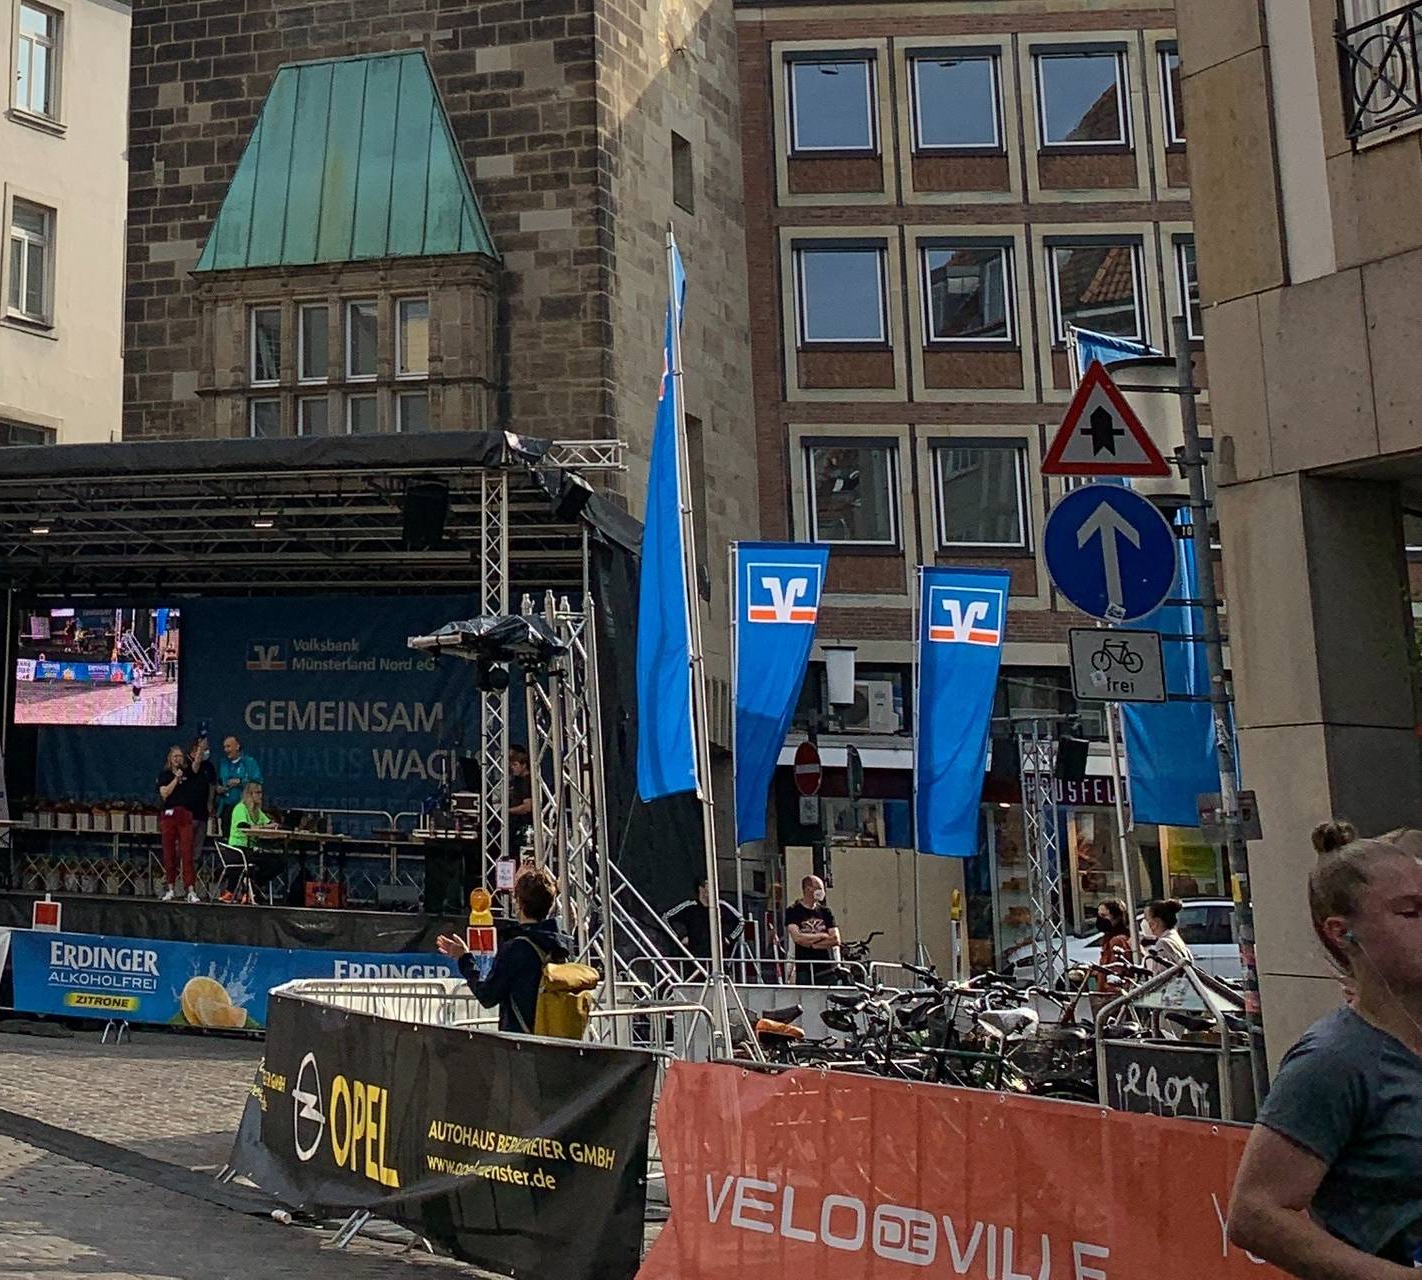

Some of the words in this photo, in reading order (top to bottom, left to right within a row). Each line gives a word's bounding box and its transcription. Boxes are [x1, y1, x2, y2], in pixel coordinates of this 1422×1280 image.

[292, 638, 359, 652] Volksbank
[292, 656, 375, 671] Münsterland
[380, 656, 413, 671] Nord
[416, 658, 435, 671] eG
[1107, 676, 1135, 694] frei
[245, 700, 443, 732] GEMEINSAM
[50, 941, 160, 976] ERDINGER
[48, 972, 157, 990] ALKOHOLFREI
[76, 995, 130, 1008] ZITRONE
[330, 1075, 400, 1188] OPEL
[428, 1119, 495, 1153] AUTOHAUS
[569, 1142, 616, 1171] GMBH
[705, 1173, 866, 1251] VELO
